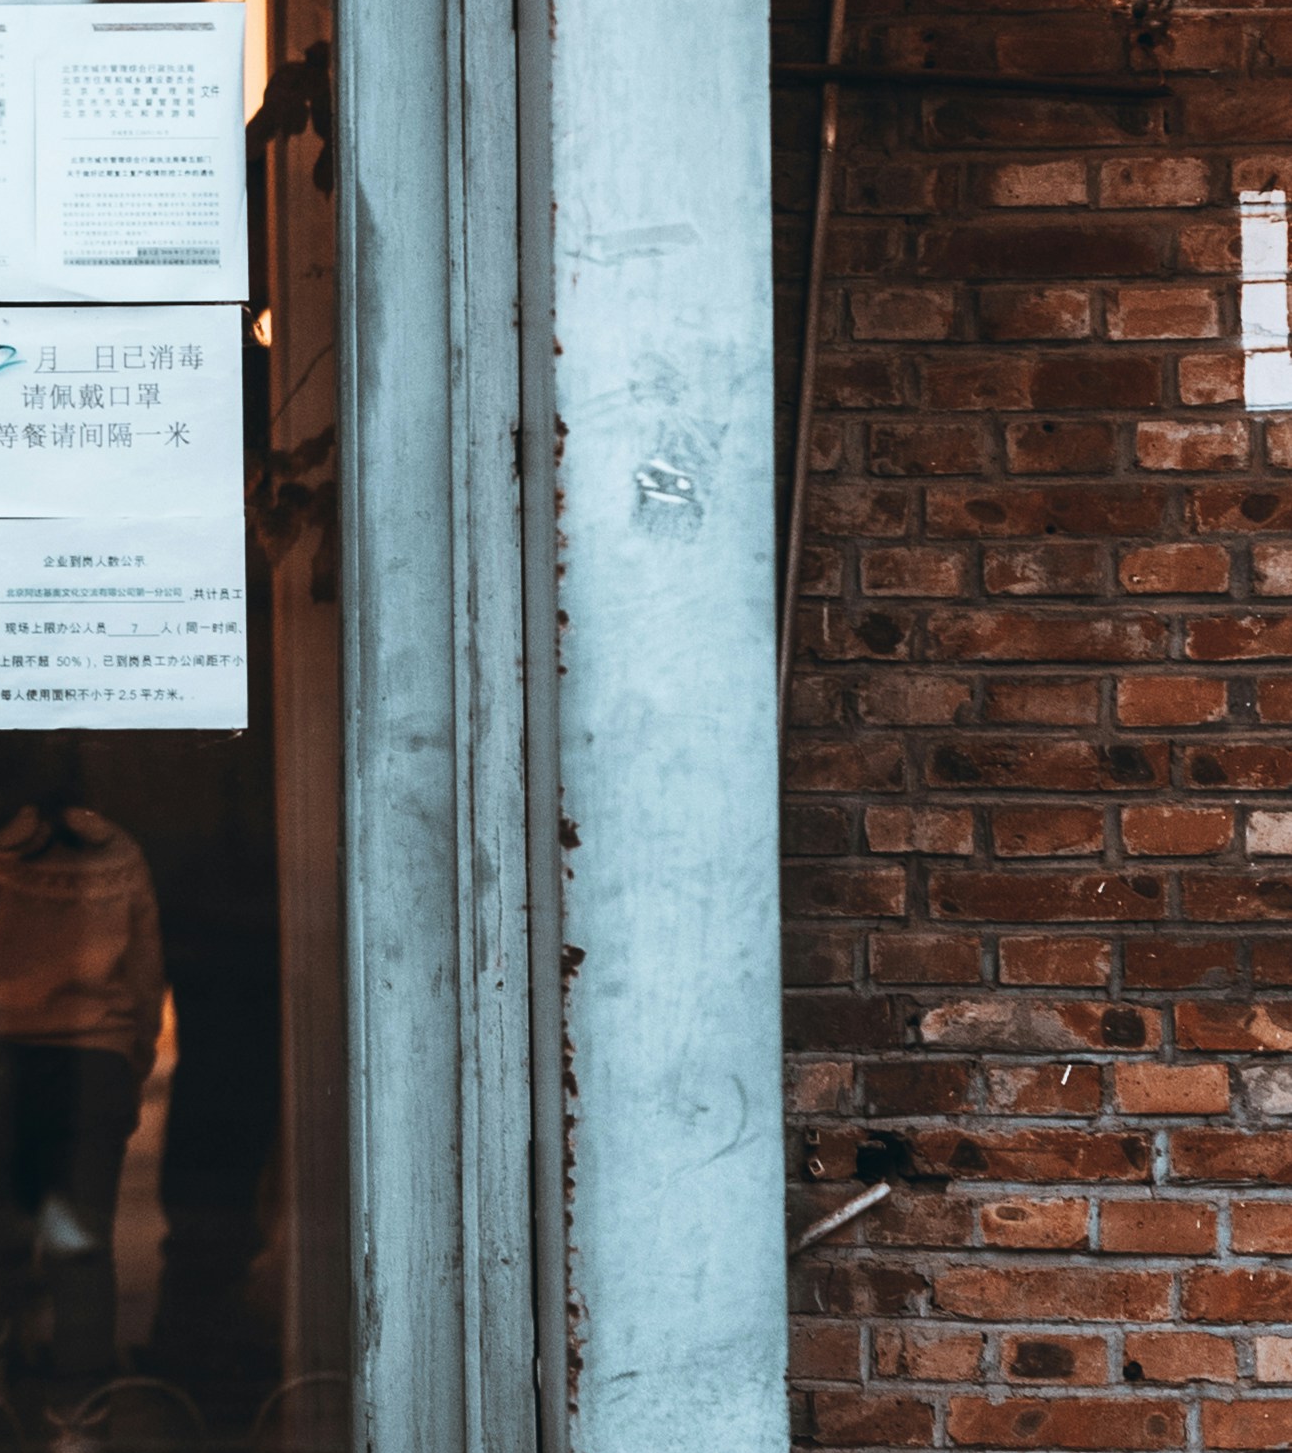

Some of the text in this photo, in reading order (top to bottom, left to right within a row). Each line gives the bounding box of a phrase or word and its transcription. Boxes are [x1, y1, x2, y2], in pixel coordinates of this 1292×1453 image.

[201, 85, 220, 98] 文件
[35, 345, 57, 372] 月
[21, 382, 162, 410] 请佩戴口罩
[43, 555, 146, 568] 企业到岗人数公示
